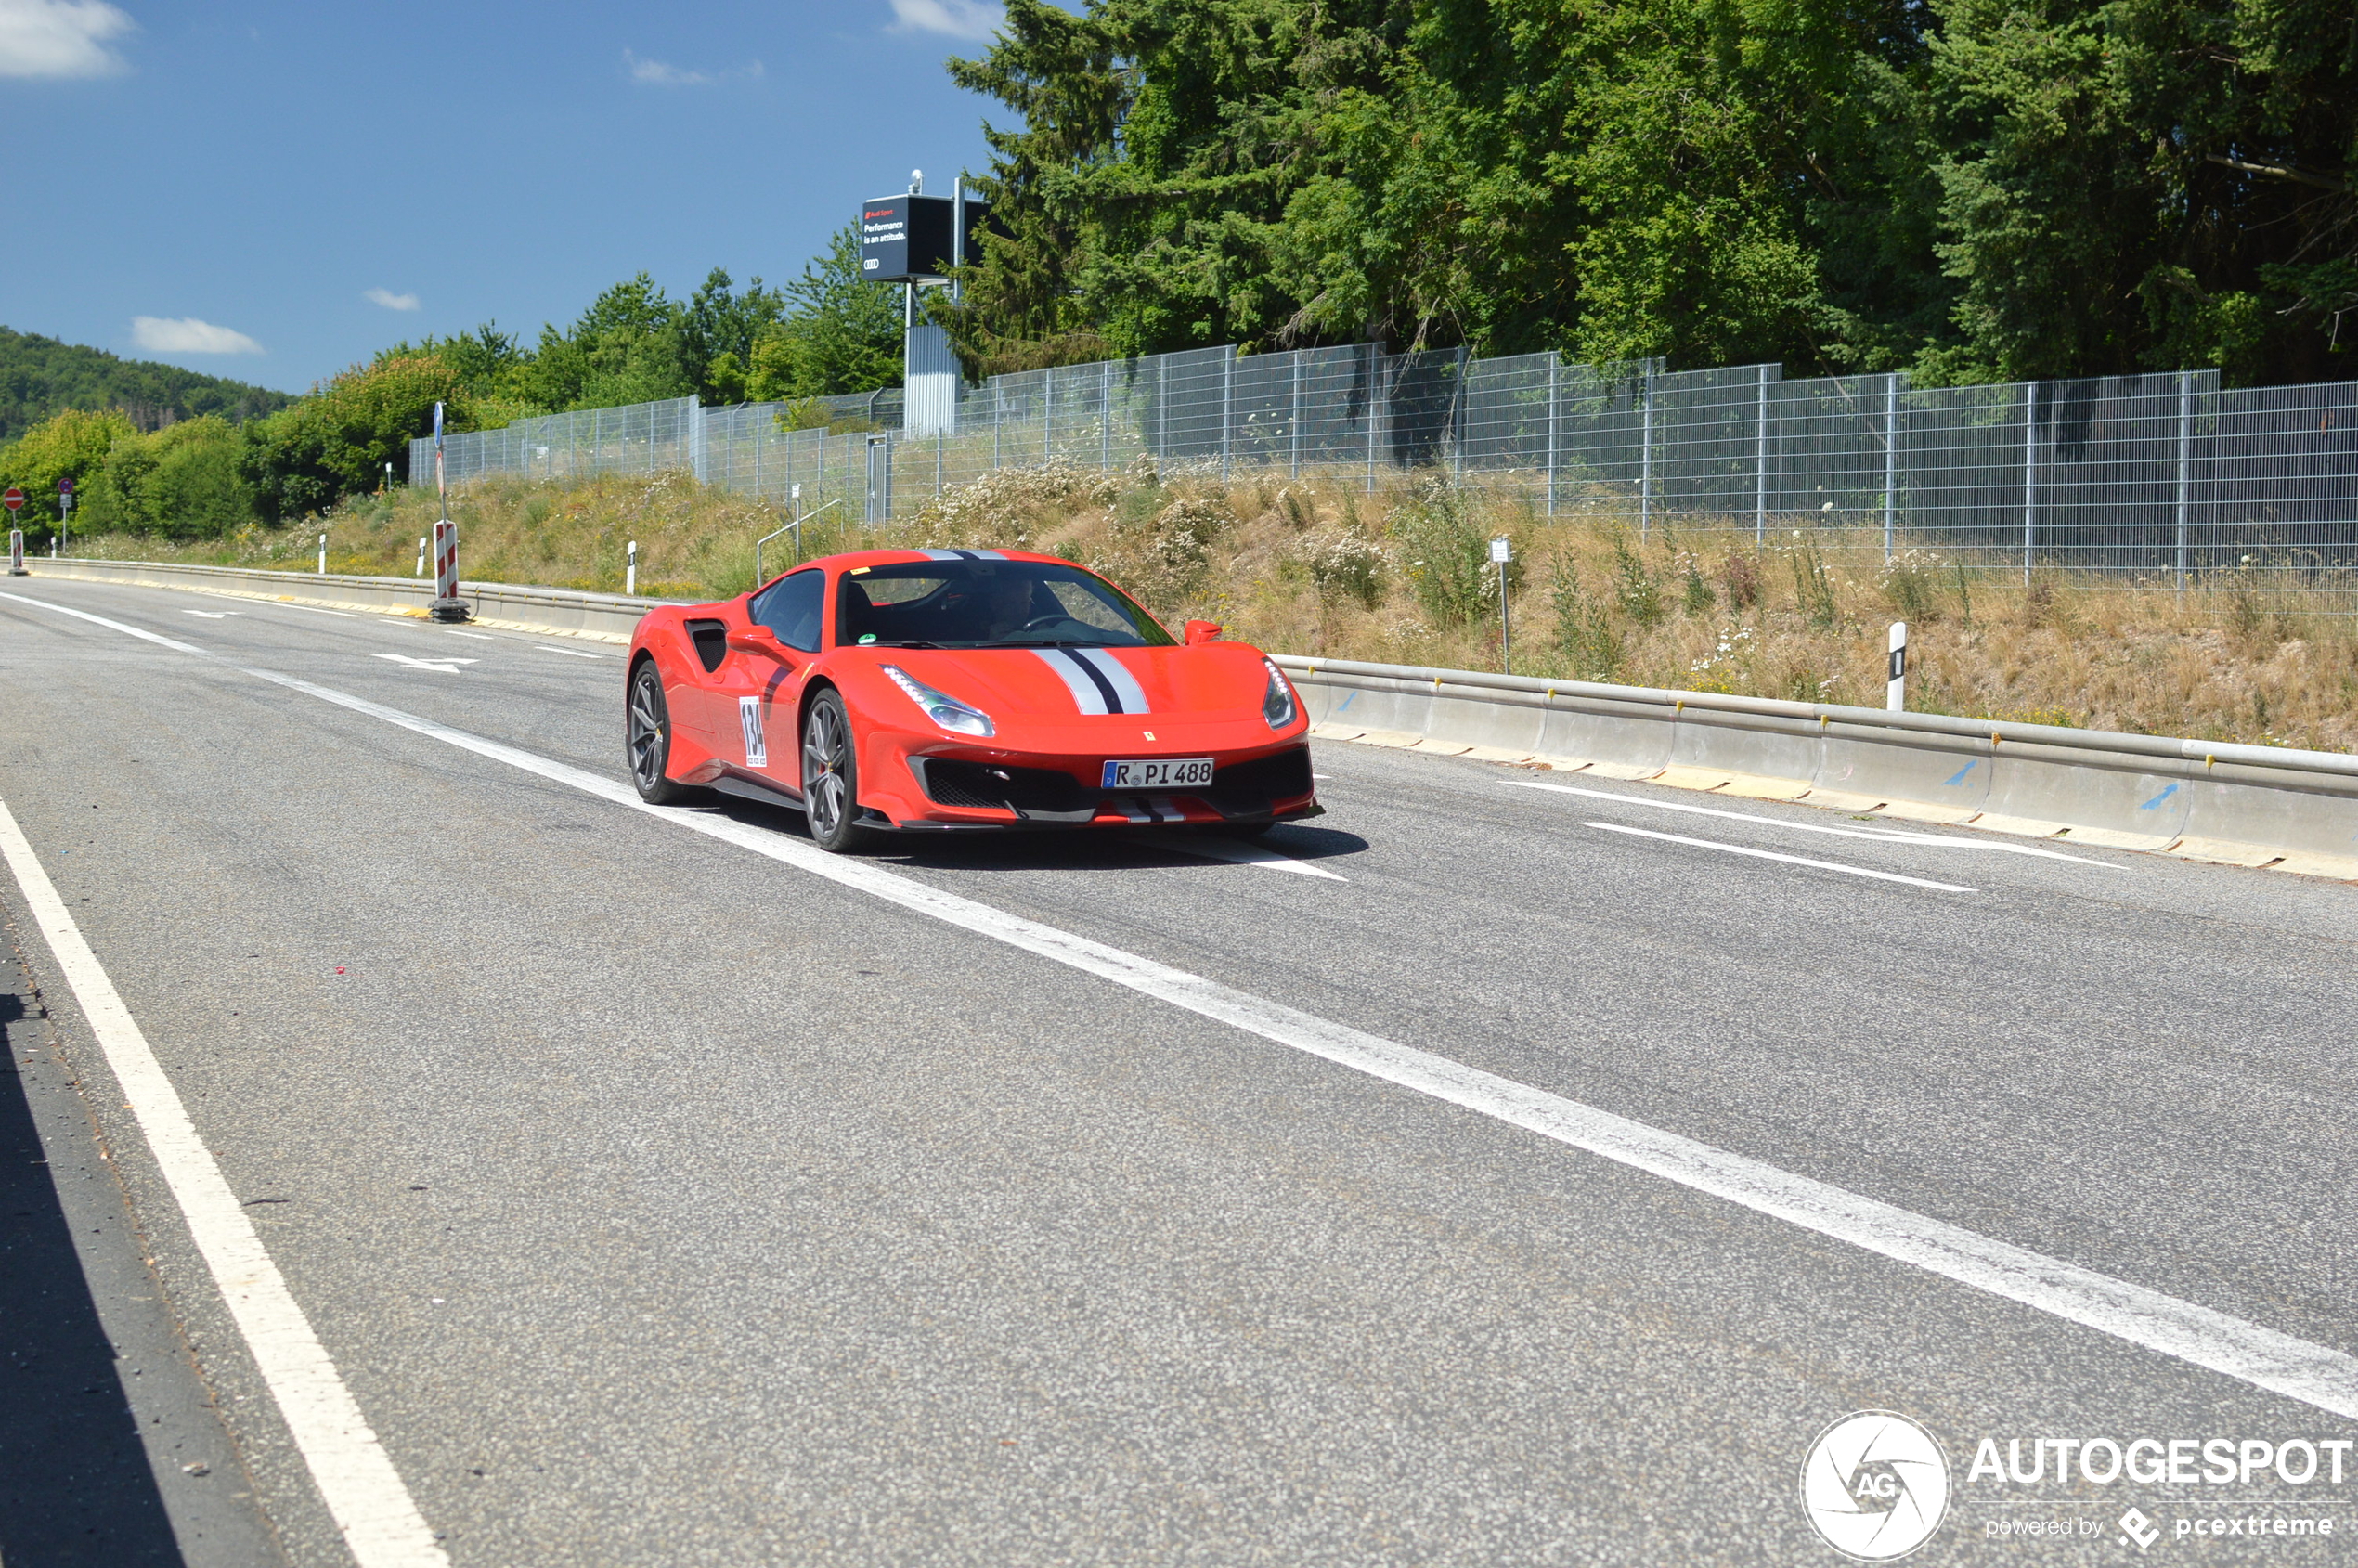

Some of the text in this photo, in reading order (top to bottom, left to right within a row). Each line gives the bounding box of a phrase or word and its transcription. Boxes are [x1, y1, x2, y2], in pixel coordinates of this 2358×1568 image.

[864, 222, 903, 232] Performance
[864, 236, 870, 244] is
[880, 231, 906, 242] attitude.
[742, 704, 764, 756] 134
[1115, 762, 1211, 784] R PI 488
